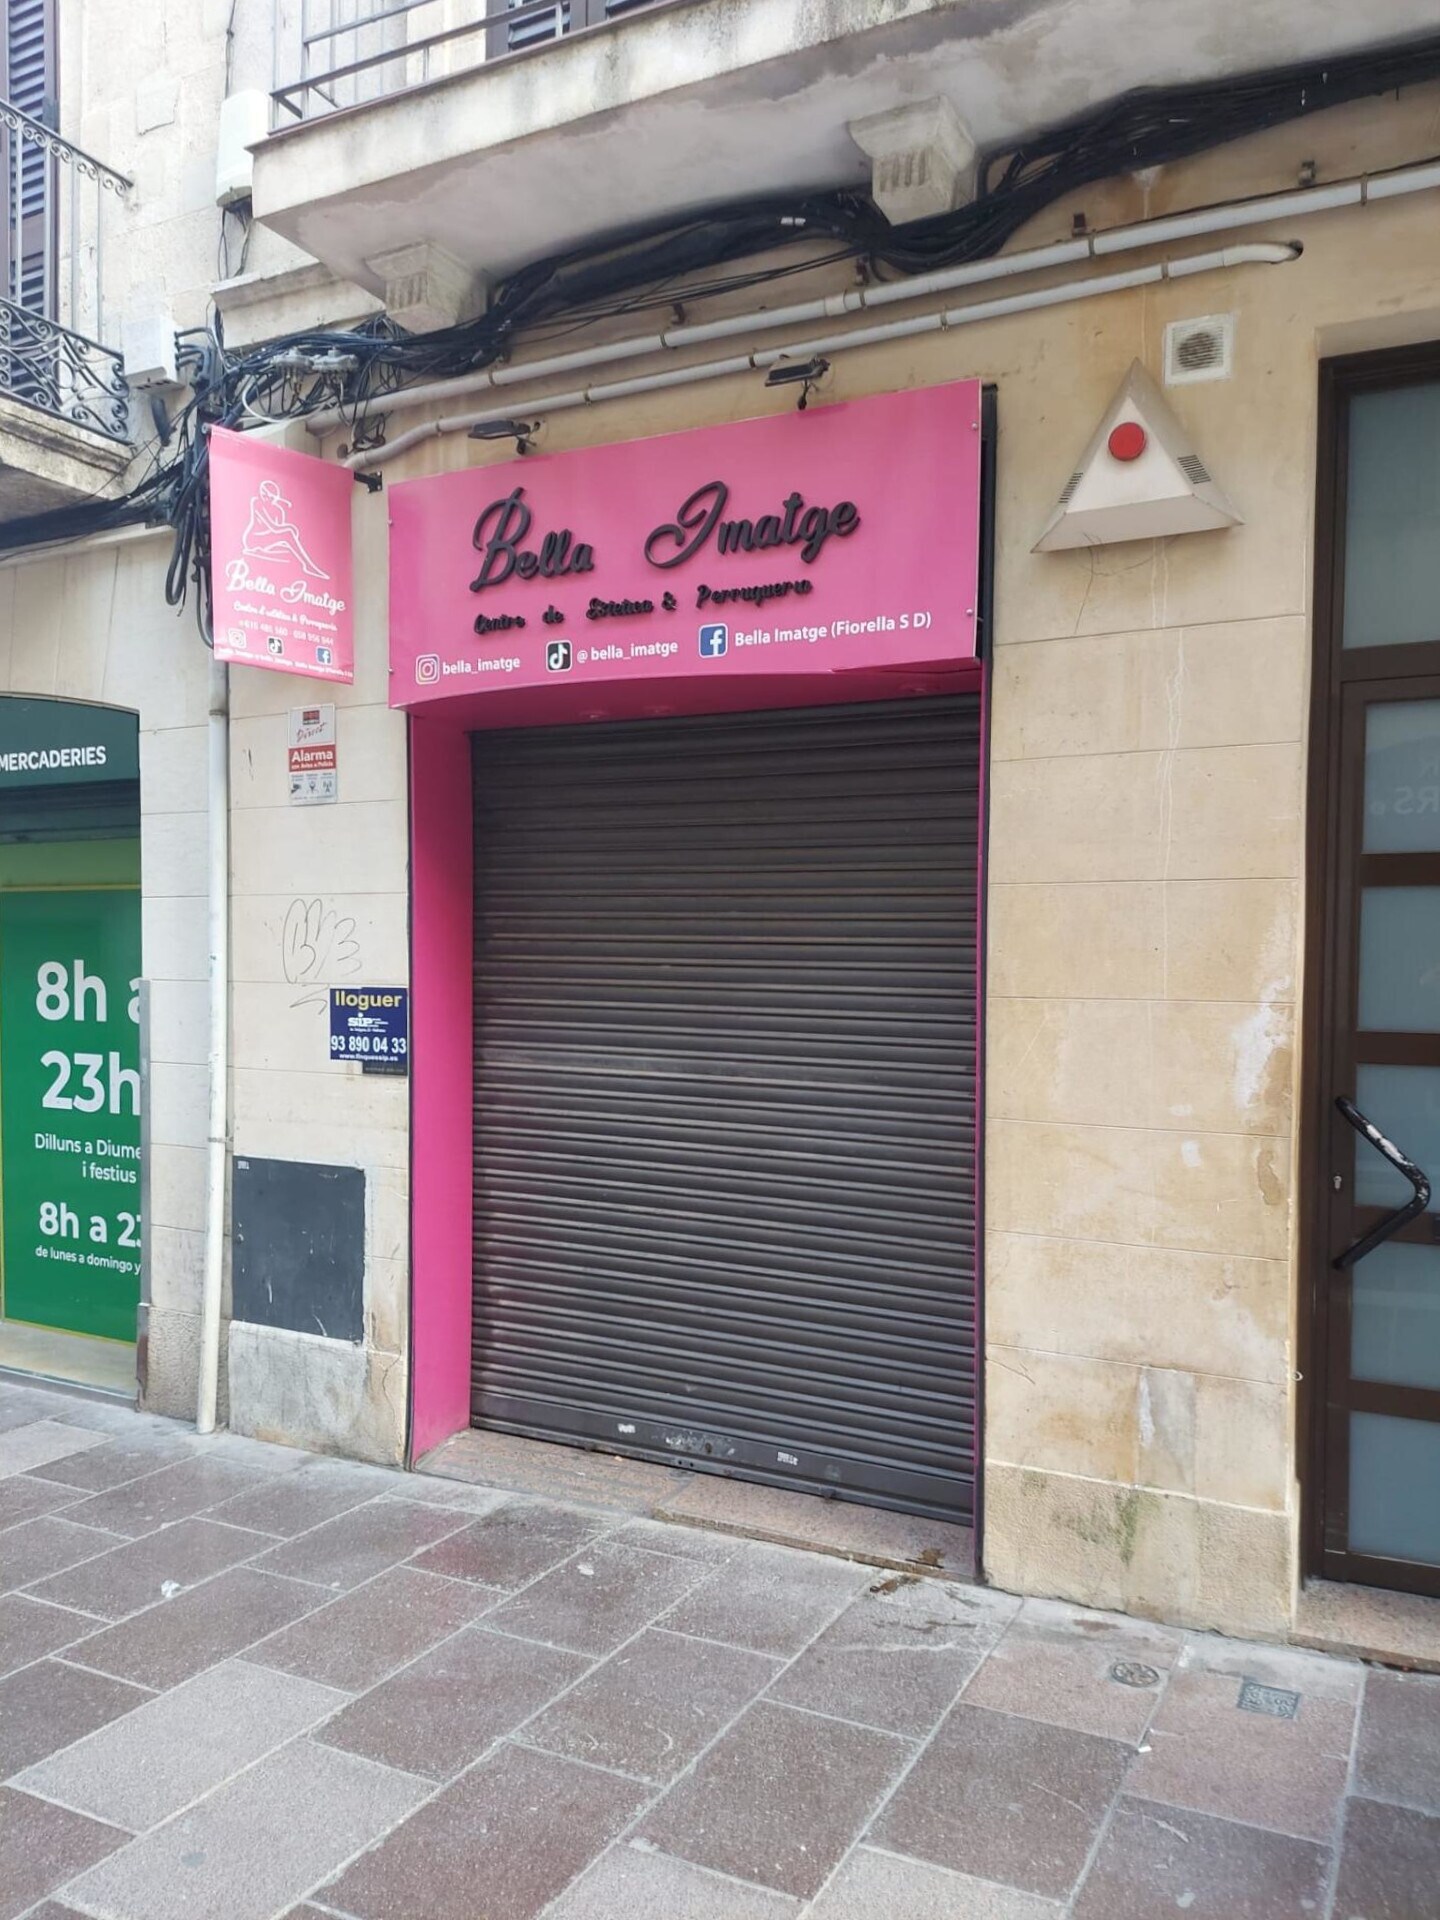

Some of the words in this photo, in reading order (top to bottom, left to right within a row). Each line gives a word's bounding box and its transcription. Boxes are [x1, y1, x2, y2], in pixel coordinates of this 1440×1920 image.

[469, 487, 595, 592] Bella
[644, 481, 861, 569] Imatge
[225, 558, 276, 596] Bella
[280, 580, 346, 617] Imatge
[661, 591, 677, 611] &
[734, 630, 771, 647] Bella
[774, 625, 827, 644] Imatge
[831, 615, 895, 639] (Fiorella
[899, 615, 910, 629] S
[913, 611, 932, 629] D)
[590, 642, 679, 663] bella_imatge
[442, 656, 521, 676] bella_imatge
[0, 745, 107, 772] MERCADERIES
[291, 749, 334, 763] Alarma
[36, 959, 107, 1022] 8h
[335, 990, 403, 1011] lloguer
[331, 1035, 346, 1051] 93
[348, 1036, 370, 1052] 890
[372, 1037, 388, 1053] 04
[391, 1038, 407, 1054] 33
[40, 1050, 140, 1116] 23h
[35, 1133, 82, 1154] Dilluns
[85, 1141, 93, 1154] a
[82, 1161, 86, 1178] i
[90, 1162, 137, 1184] festius
[39, 1201, 79, 1239] 8h
[89, 1215, 108, 1243] a
[117, 1211, 141, 1248] 2
[35, 1245, 48, 1258] de
[50, 1247, 77, 1262] lunes
[78, 1254, 85, 1264] a
[87, 1253, 133, 1274] domingo
[134, 1262, 141, 1275] y
